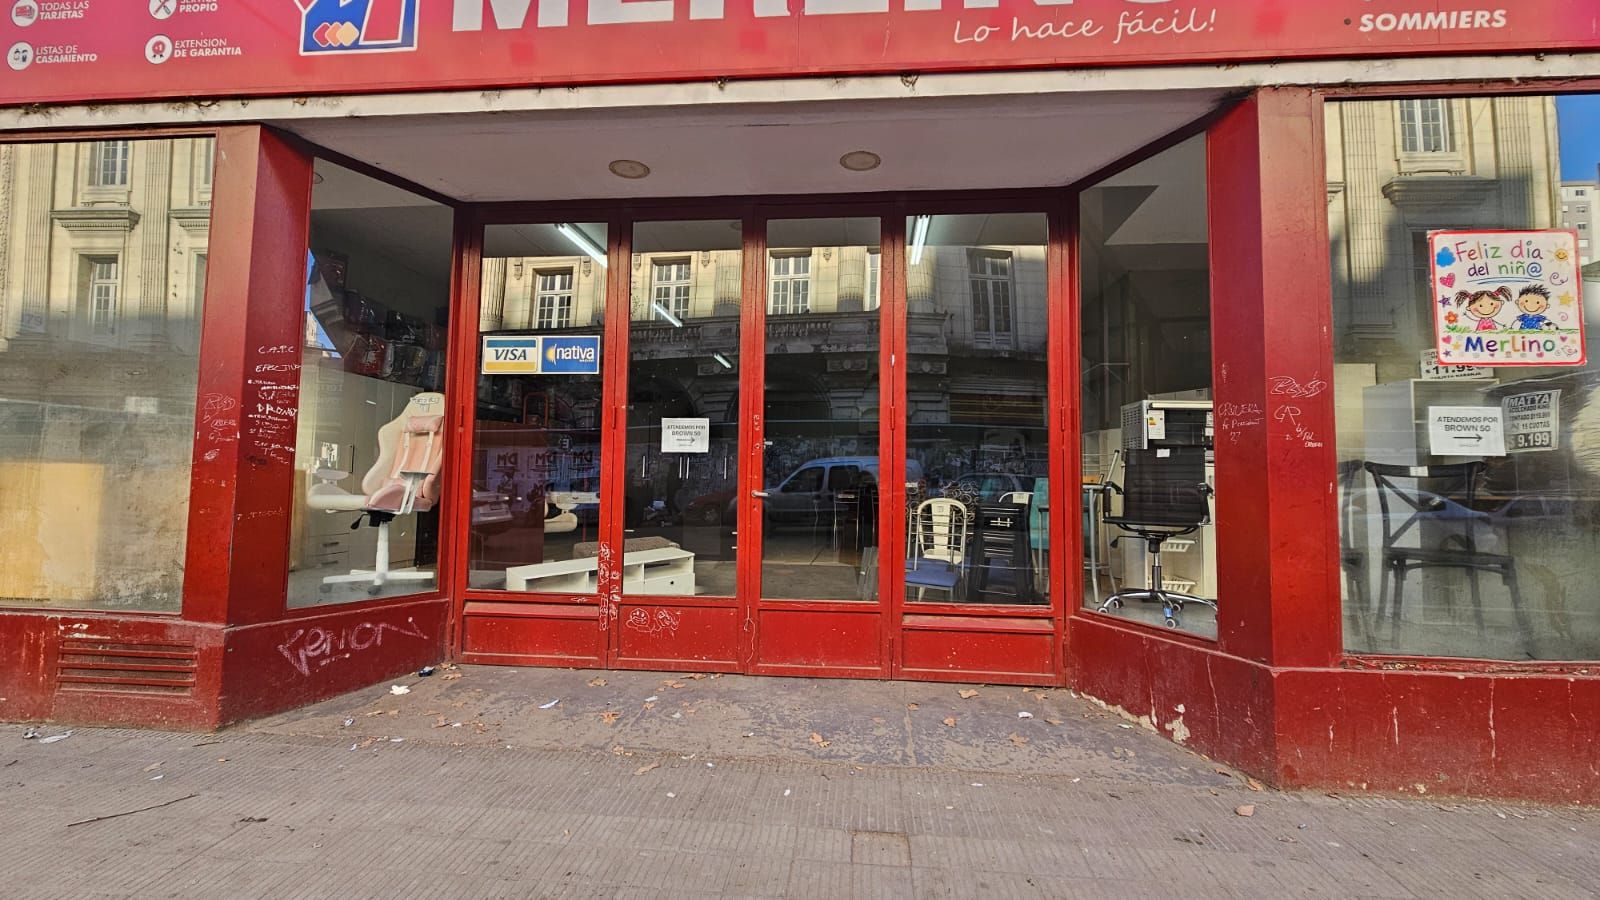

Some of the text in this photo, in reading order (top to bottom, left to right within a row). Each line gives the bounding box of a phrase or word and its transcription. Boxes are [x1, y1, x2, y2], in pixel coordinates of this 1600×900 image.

[40, 1, 90, 12] TODAS LAS
[179, 3, 218, 13] PROPIO
[40, 10, 84, 20] TARJETAS
[1359, 9, 1507, 32] SOMMIERS
[954, 20, 1000, 43] Lo
[1011, 16, 1103, 41] hace
[1113, 9, 1217, 44] fácil!
[174, 38, 227, 49] EXTENSION
[35, 45, 78, 55] LISTAS DE
[174, 46, 242, 58] DE GARANTIA
[35, 53, 98, 64] CASAMIENTO
[1455, 240, 1503, 262] Feliz
[1467, 260, 1543, 278] del niñ@
[1464, 335, 1556, 353] Merlino
[493, 348, 527, 361] VISA
[556, 345, 595, 360] nativa
[1436, 416, 1499, 424] ATENDEMOS POR
[1444, 424, 1478, 432] BROWN
[1517, 432, 1550, 447] 9.199
